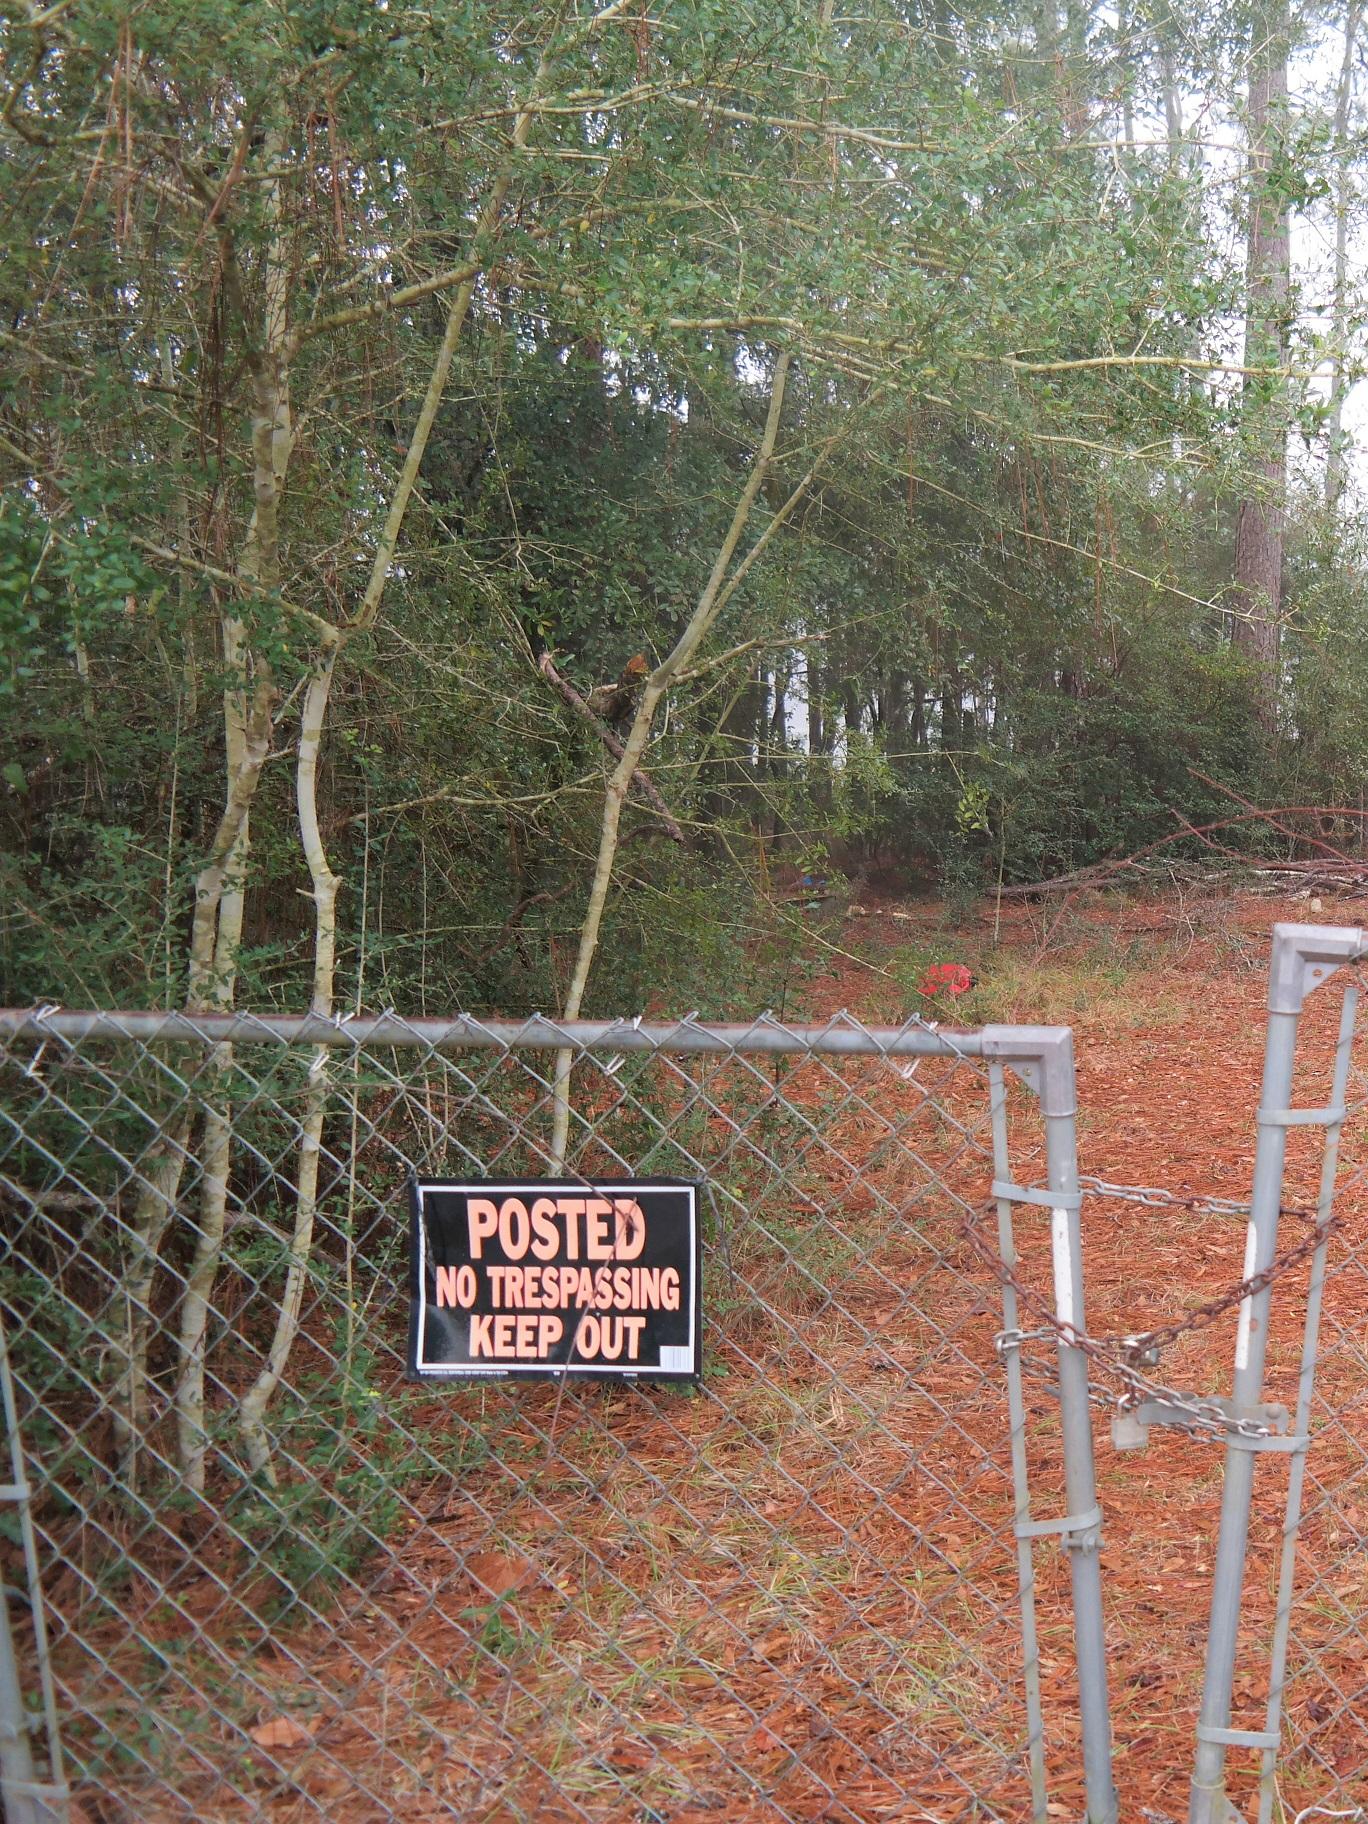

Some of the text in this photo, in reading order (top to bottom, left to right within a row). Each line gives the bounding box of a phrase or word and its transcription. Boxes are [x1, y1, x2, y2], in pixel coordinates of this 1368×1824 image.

[467, 1197, 646, 1261] POSTED
[436, 1264, 680, 1311] NO TRESPASSING
[469, 1314, 646, 1360] KEEP OUT
